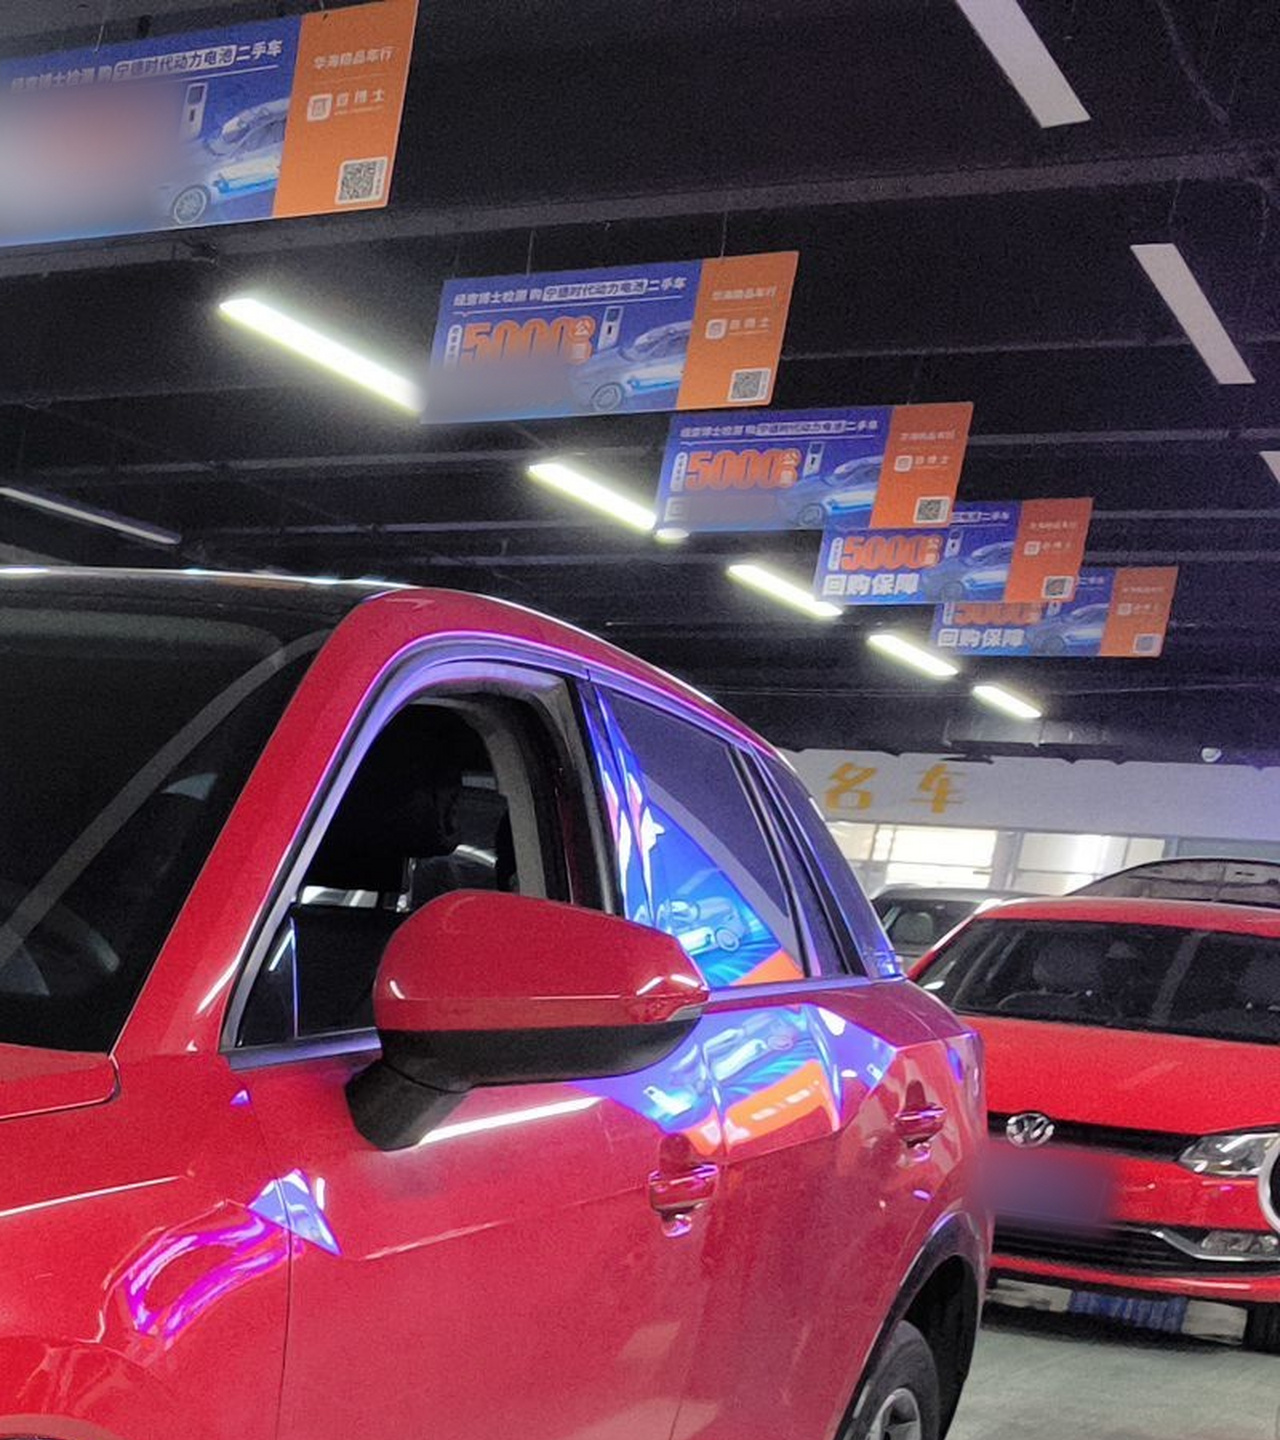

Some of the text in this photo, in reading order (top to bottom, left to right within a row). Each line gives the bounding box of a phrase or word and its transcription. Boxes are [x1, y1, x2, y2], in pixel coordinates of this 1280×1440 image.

[685, 449, 783, 490] 5000
[841, 534, 924, 571] 5000
[823, 573, 920, 596] 回购保障
[938, 628, 1026, 648] 回购保障
